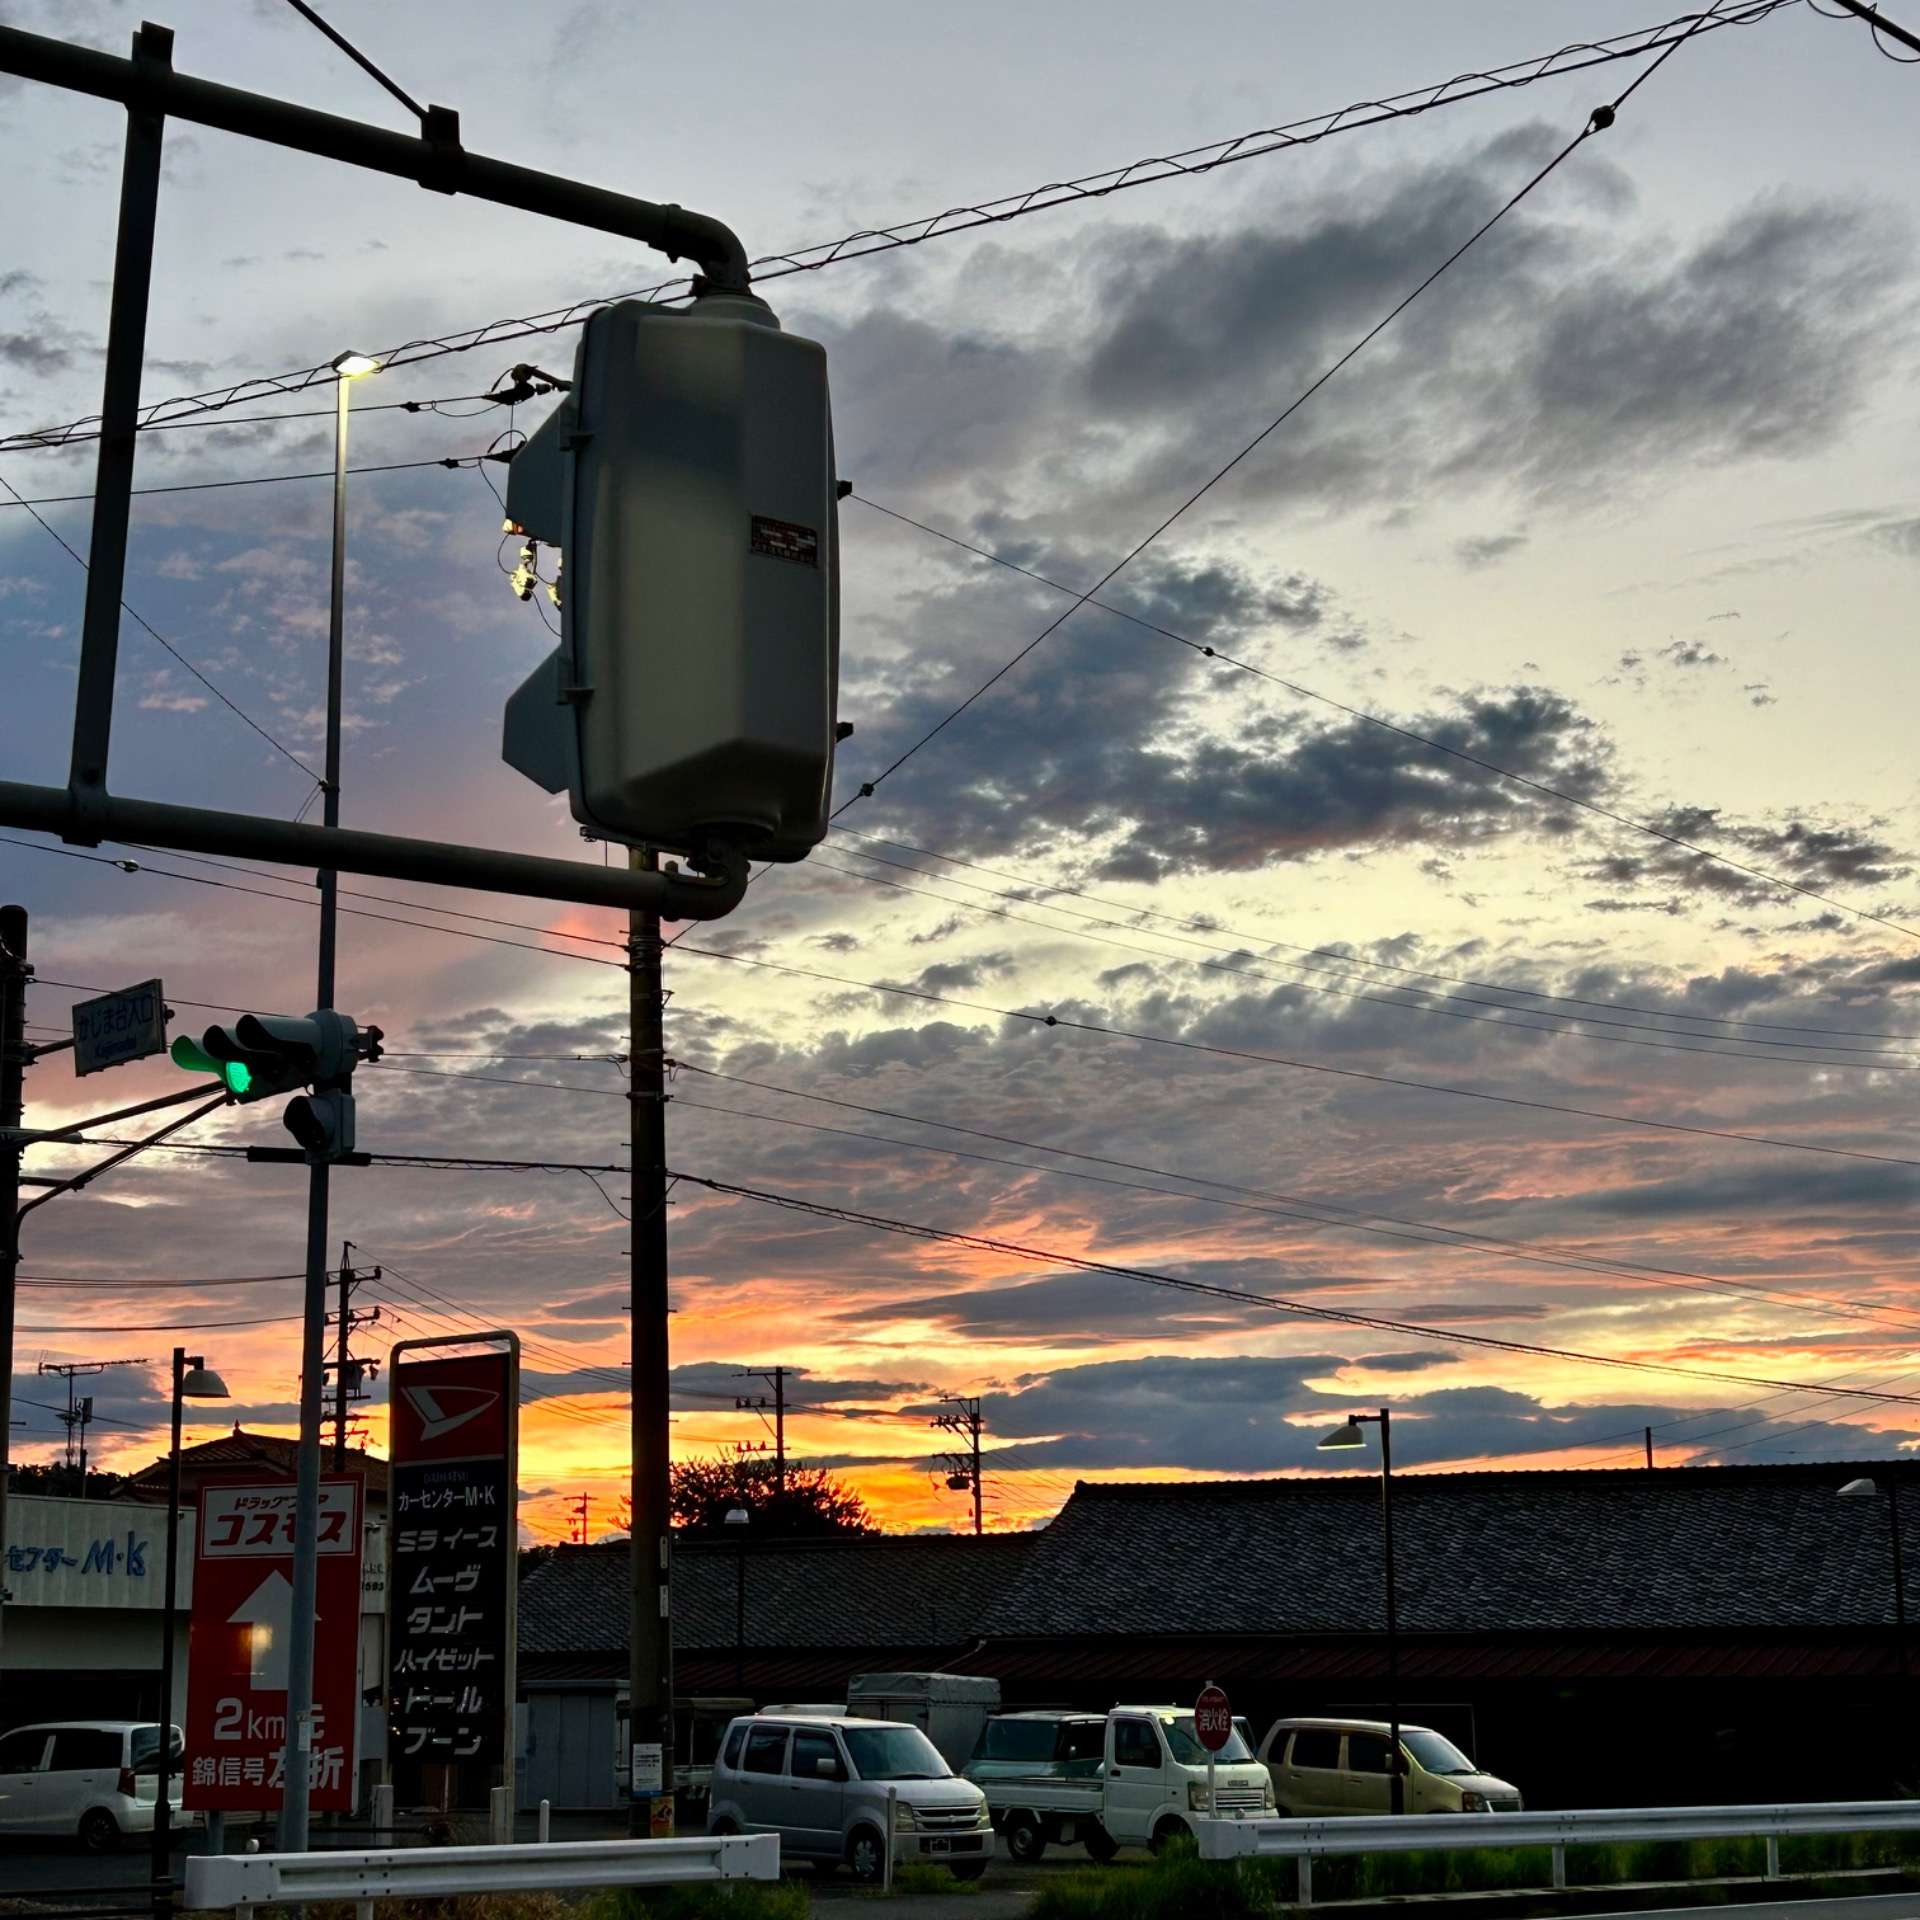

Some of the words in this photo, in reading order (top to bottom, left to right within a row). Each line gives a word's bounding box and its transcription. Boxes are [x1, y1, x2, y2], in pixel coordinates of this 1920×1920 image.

[409, 1563, 481, 1594] ムーヴ
[407, 1605, 483, 1634] タント
[393, 1647, 495, 1673] ハイゼット
[404, 1686, 483, 1713] トール
[1199, 1707, 1230, 1732] 消火栓
[403, 1727, 482, 1755] ブーン
